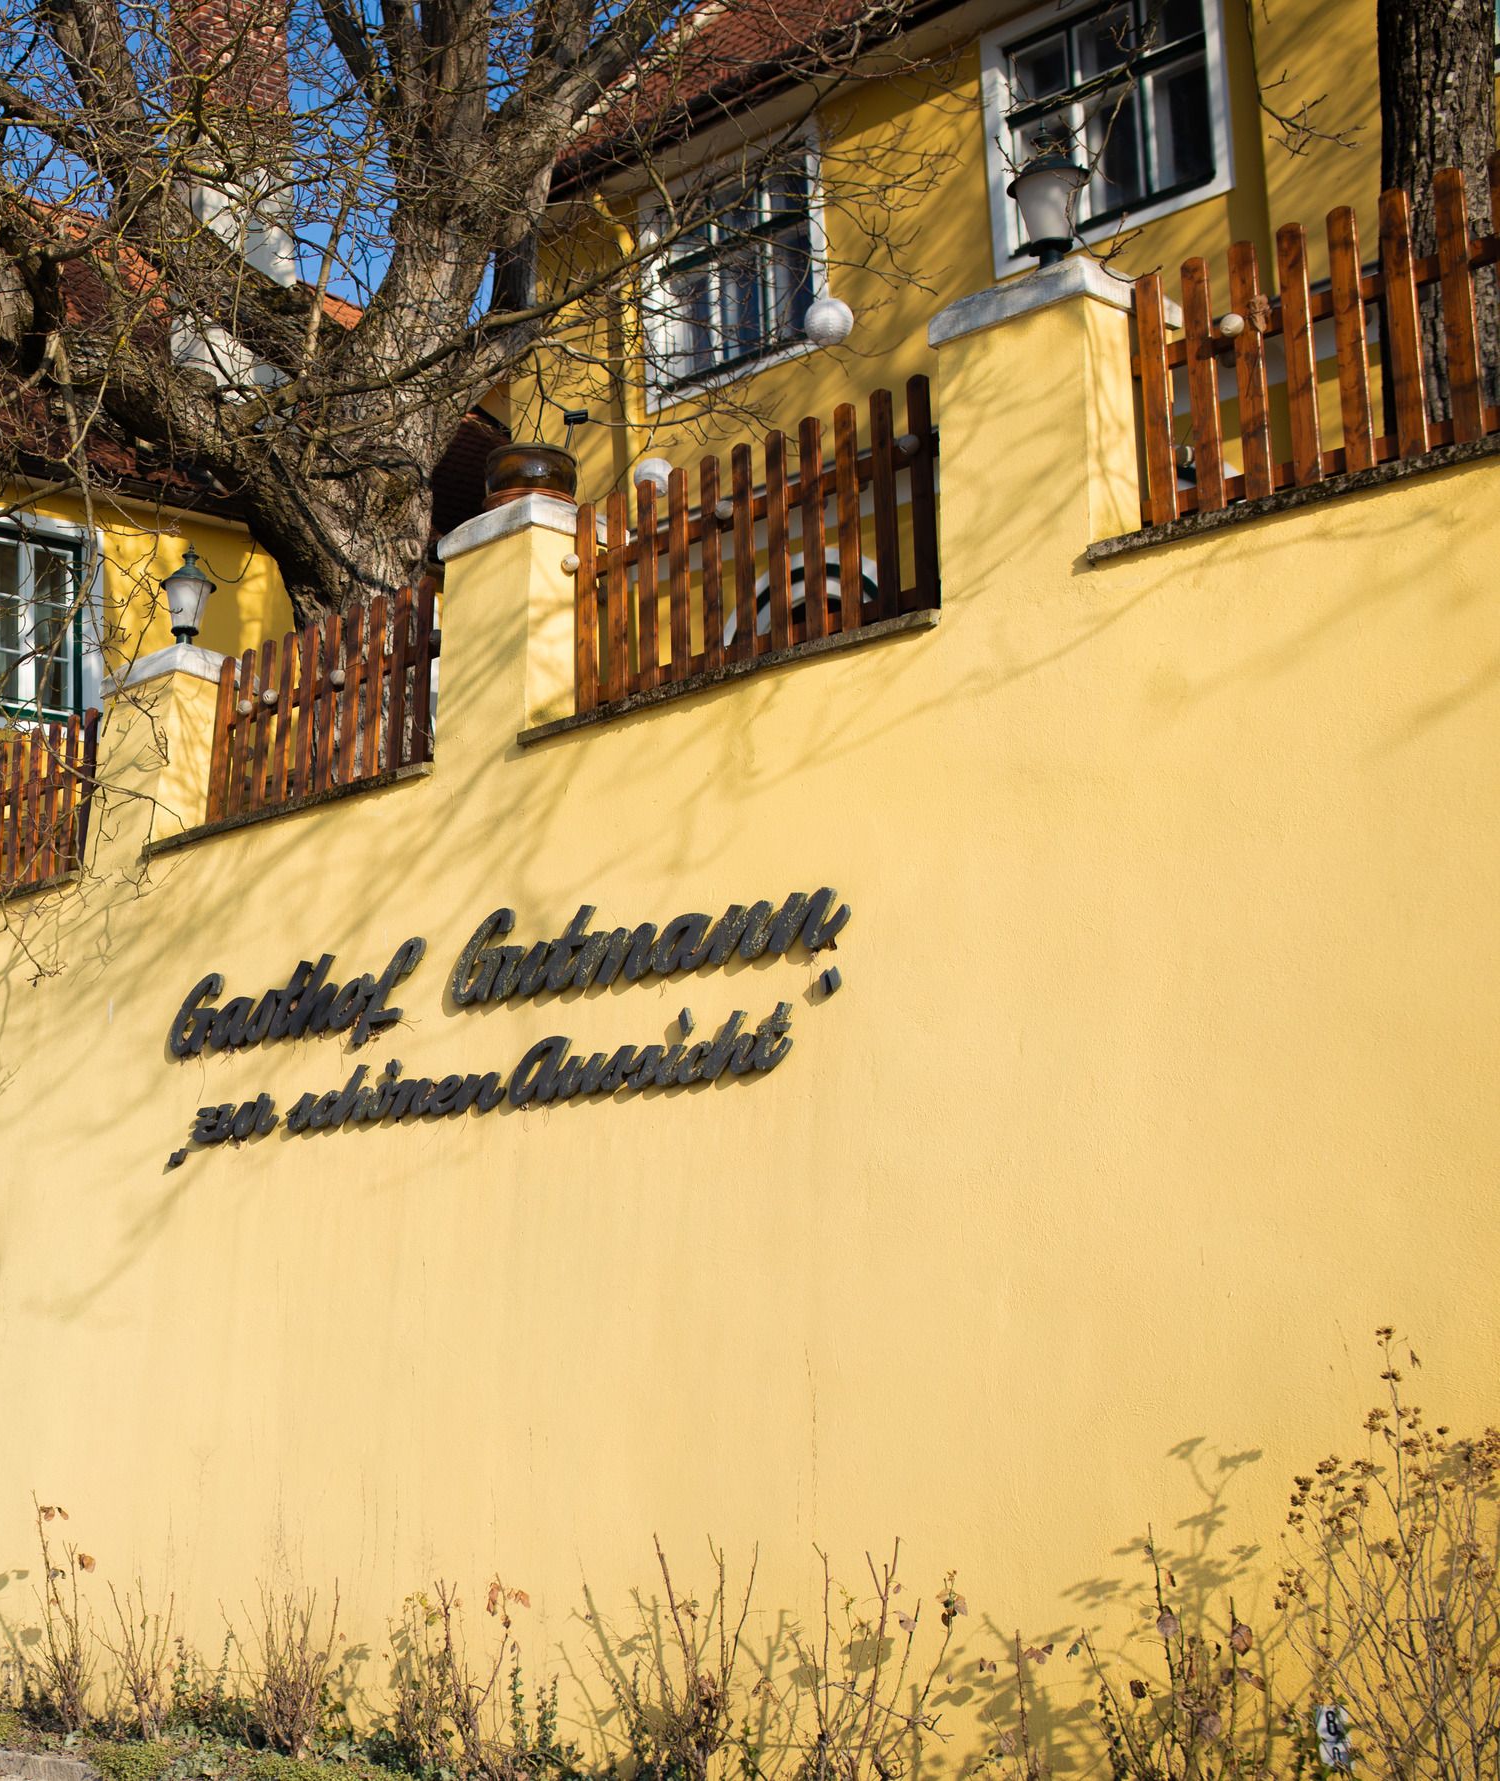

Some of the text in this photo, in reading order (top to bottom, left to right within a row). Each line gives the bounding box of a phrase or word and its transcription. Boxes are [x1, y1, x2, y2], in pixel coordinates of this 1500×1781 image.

[170, 887, 851, 1056] Gasthof Gutmann
[286, 1058, 506, 1132] schönen
